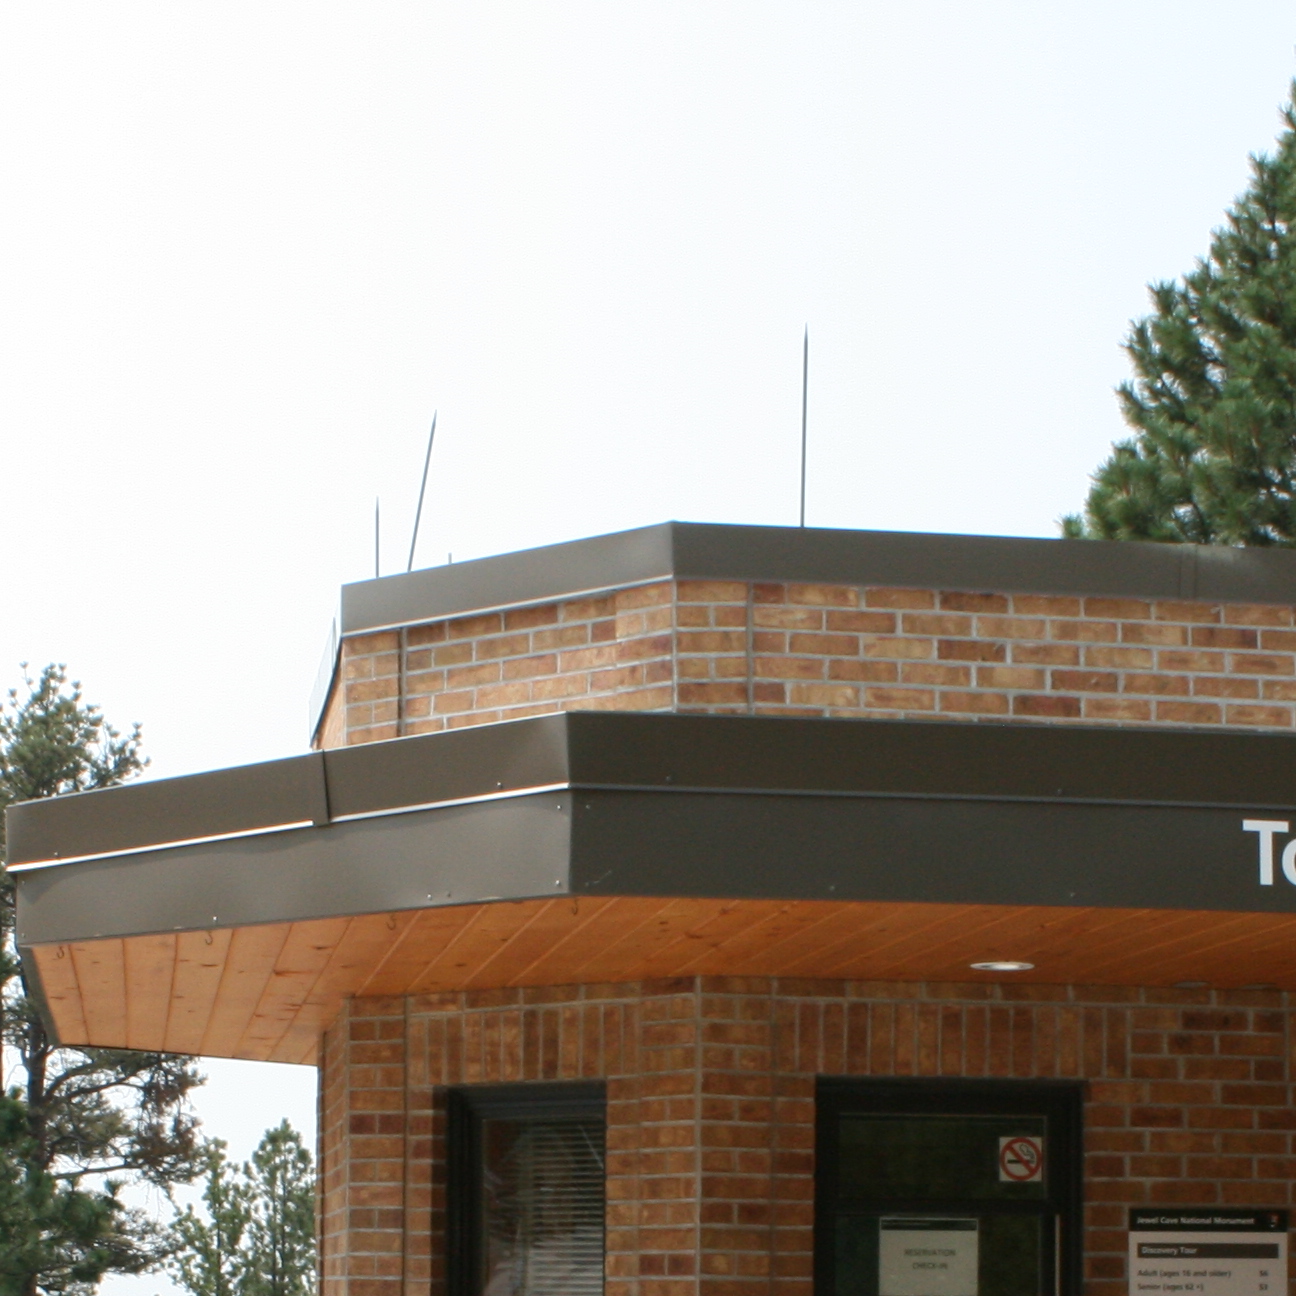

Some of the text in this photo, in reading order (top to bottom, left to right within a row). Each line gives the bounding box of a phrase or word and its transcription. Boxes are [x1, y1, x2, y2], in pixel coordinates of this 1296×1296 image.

[1137, 1217, 1254, 1225] Jewel Cave National Monument
[1142, 1247, 1178, 1255] Discovery
